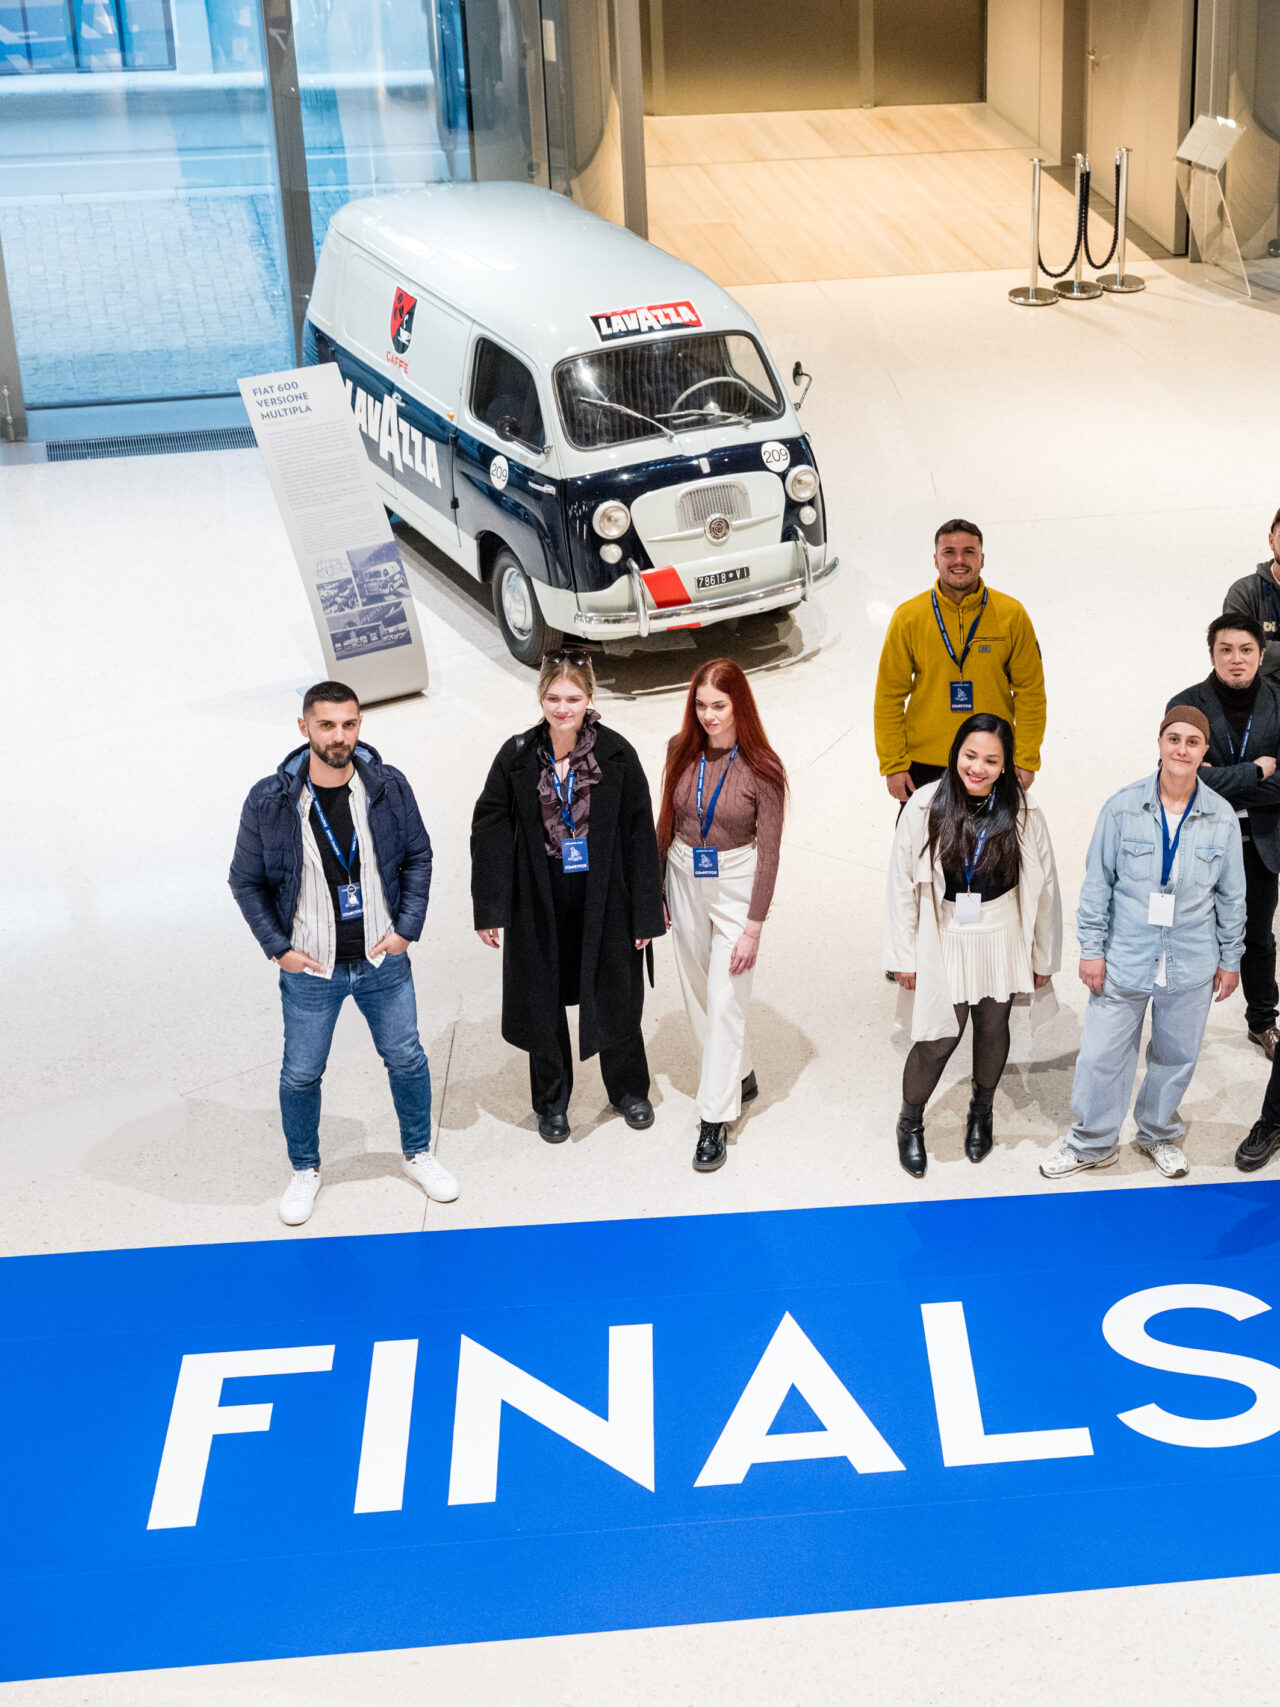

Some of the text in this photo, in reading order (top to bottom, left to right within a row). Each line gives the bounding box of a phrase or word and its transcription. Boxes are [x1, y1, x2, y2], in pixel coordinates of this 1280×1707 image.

[598, 308, 697, 336] LAVAZZA
[252, 381, 299, 397] FIAT 600
[256, 392, 309, 408] VERSIONE
[261, 405, 312, 421] MULTIPLA
[763, 448, 789, 463] 209
[491, 463, 508, 481] 209
[698, 572, 727, 588] 78618
